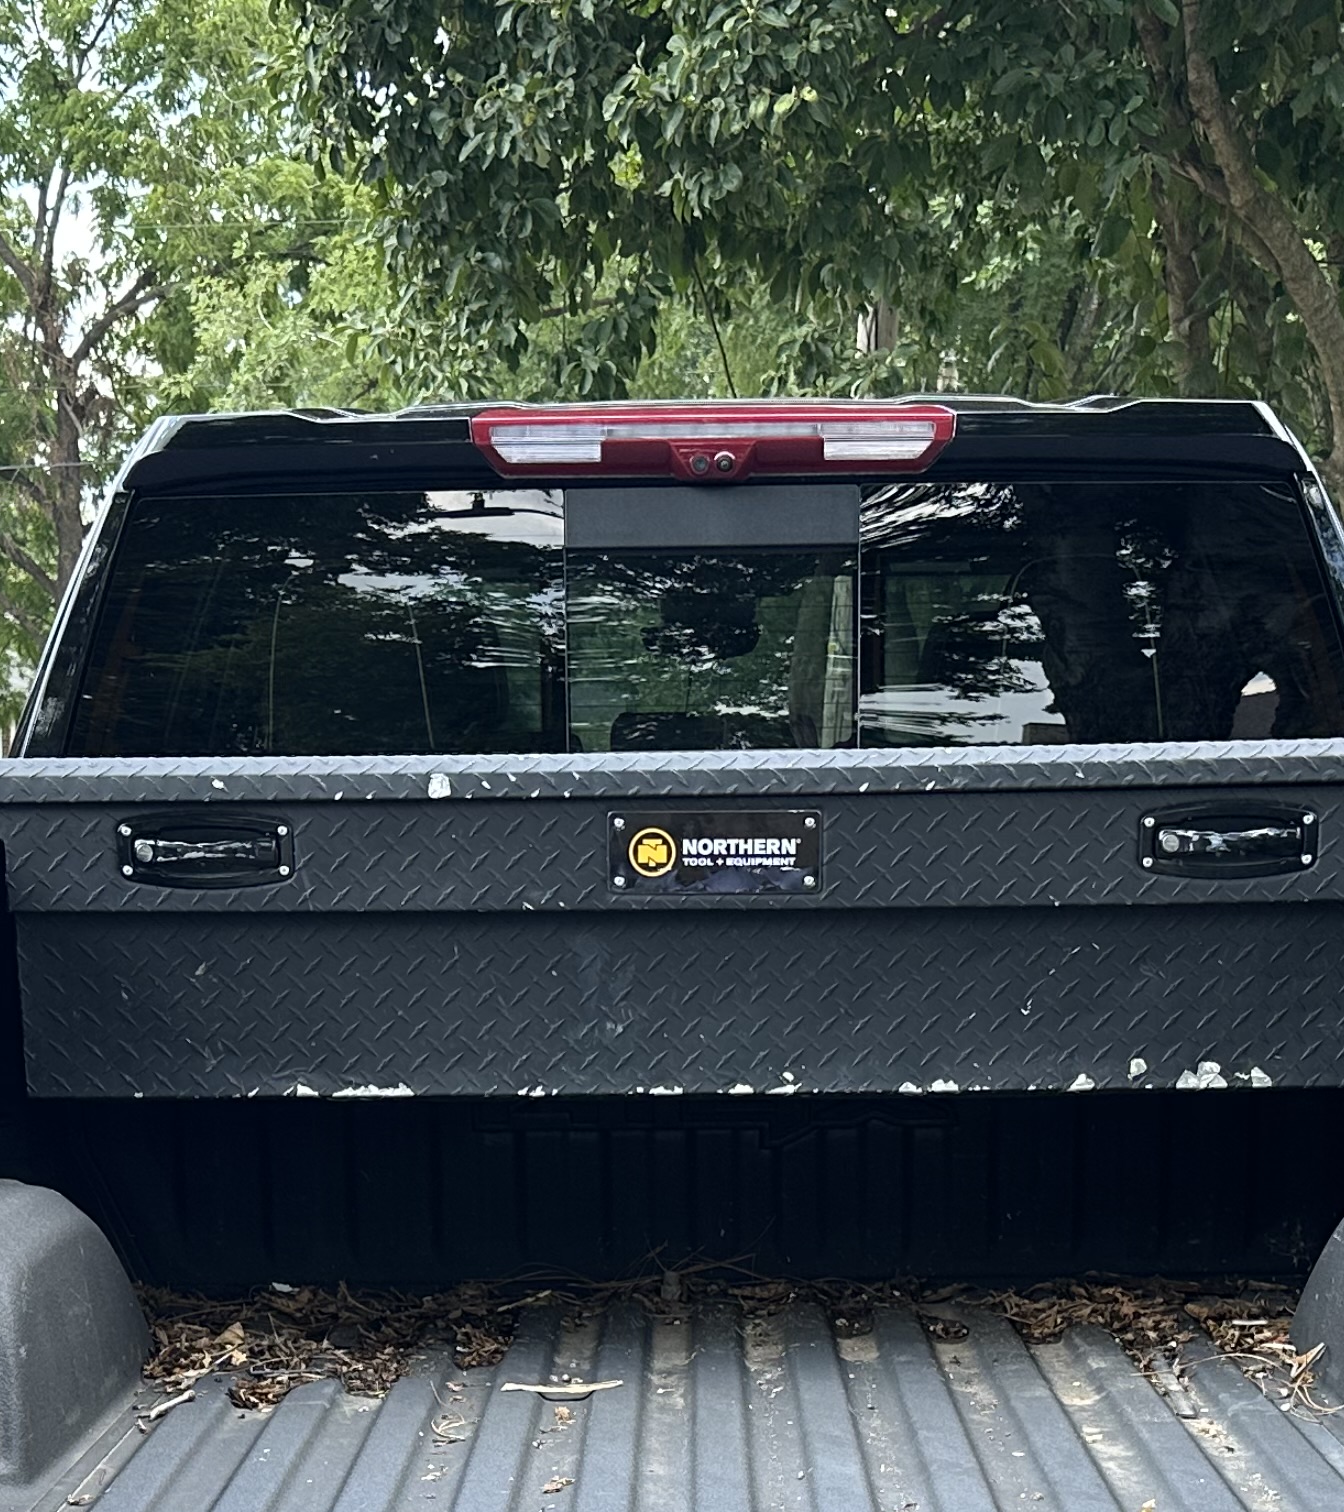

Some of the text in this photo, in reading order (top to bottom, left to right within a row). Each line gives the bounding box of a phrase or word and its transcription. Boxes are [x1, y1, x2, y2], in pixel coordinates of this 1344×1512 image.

[682, 838, 797, 855] NORTHERN
[682, 857, 714, 867] TOOL
[725, 857, 796, 867] EQUIPMENT
